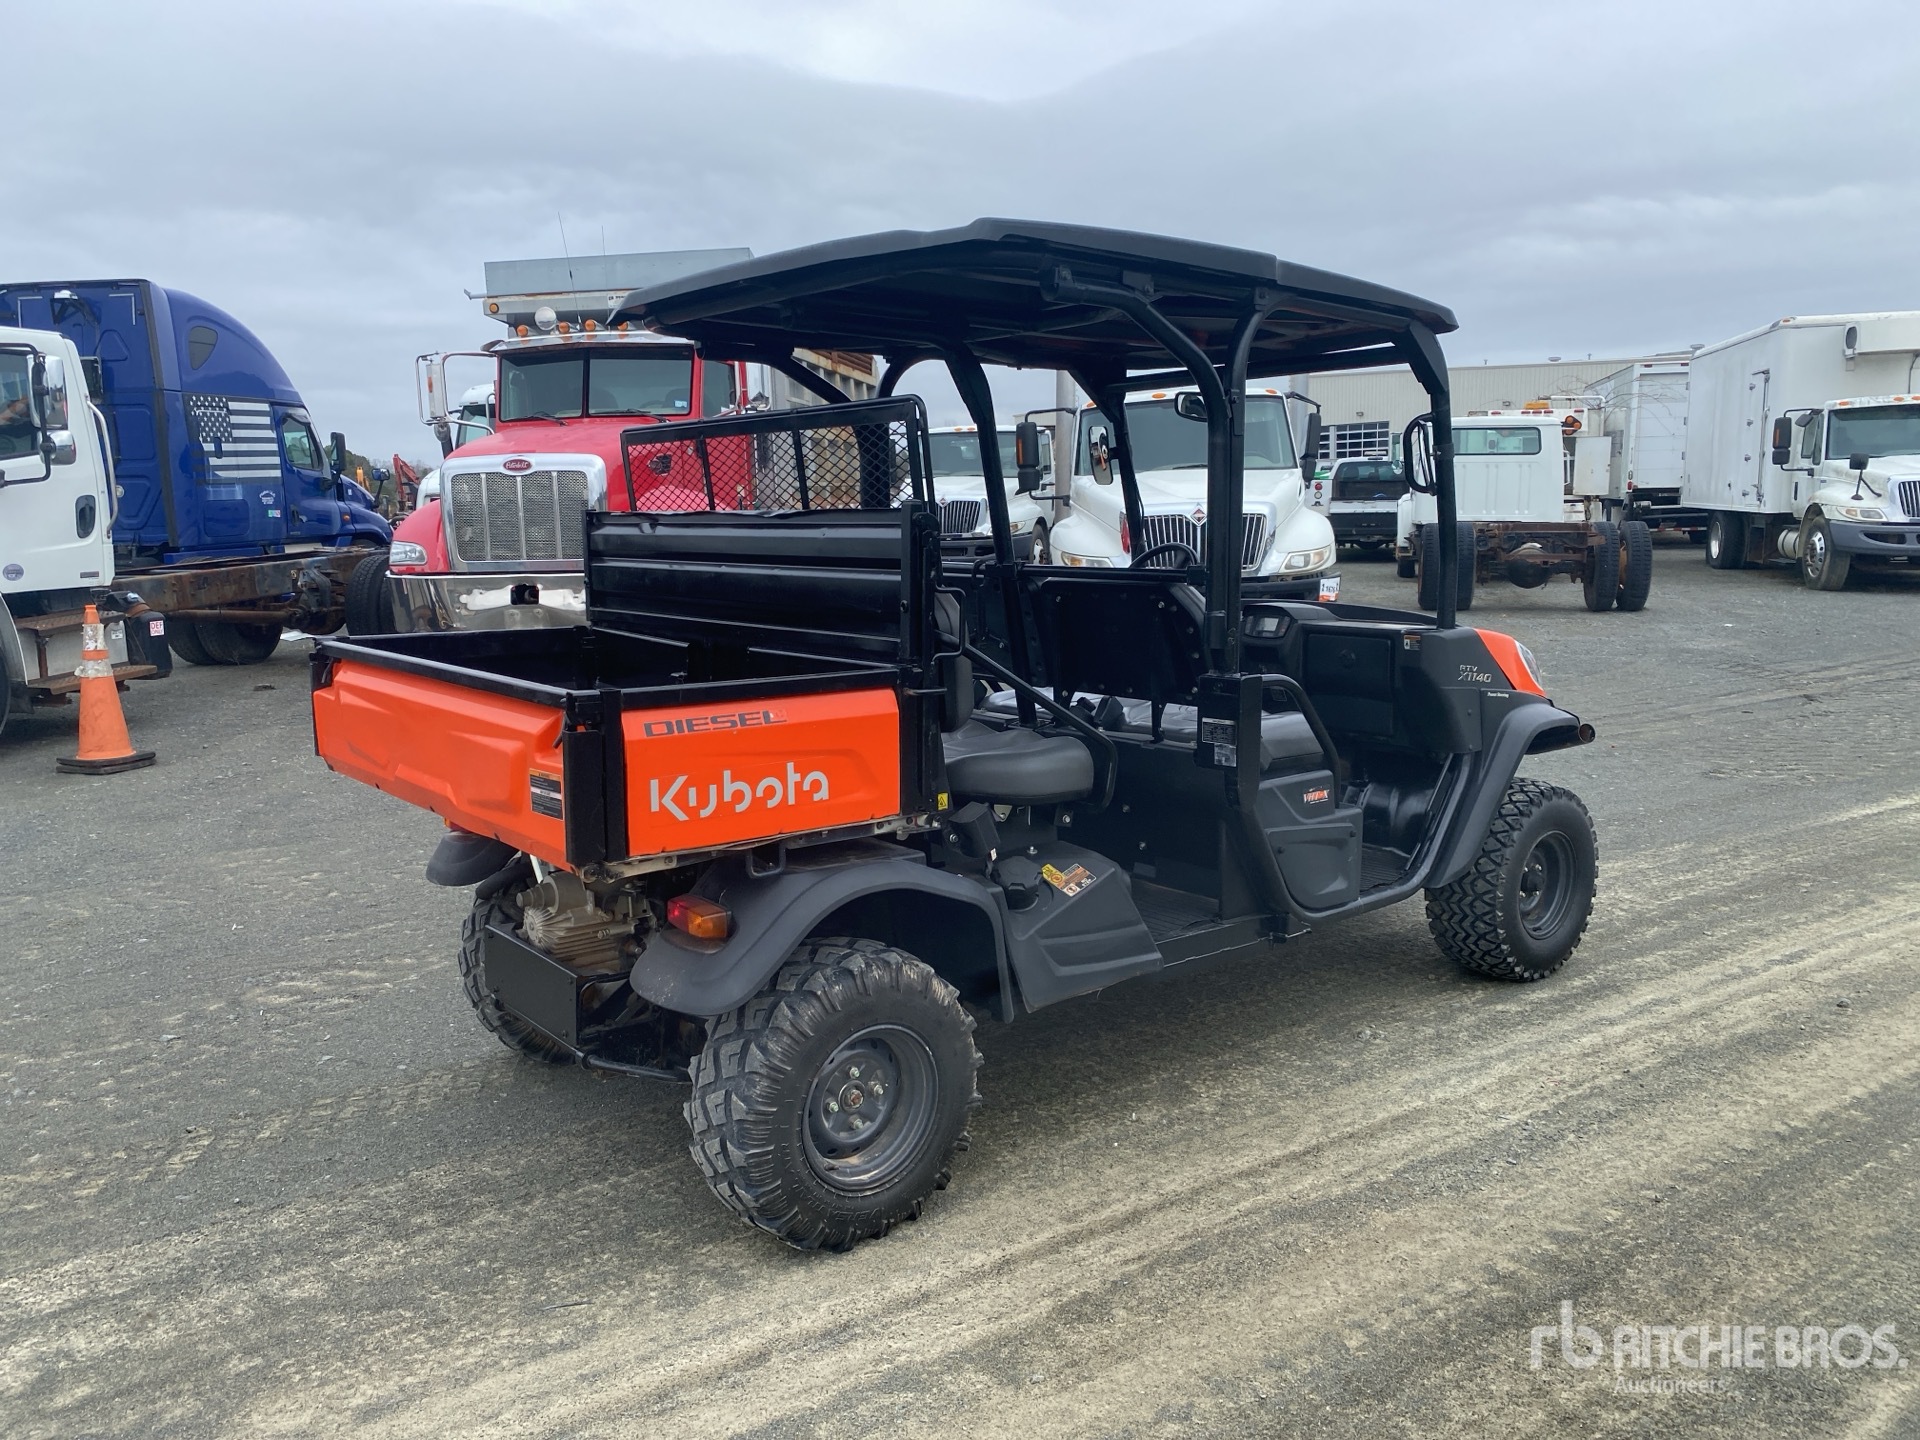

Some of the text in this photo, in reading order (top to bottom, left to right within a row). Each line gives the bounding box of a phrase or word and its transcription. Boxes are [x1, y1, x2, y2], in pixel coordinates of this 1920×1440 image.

[150, 621, 163, 629] DEF
[1459, 664, 1478, 672] RTV
[1457, 671, 1492, 683] X1140
[643, 710, 787, 737] DIESEL
[650, 761, 829, 822] Kubota
